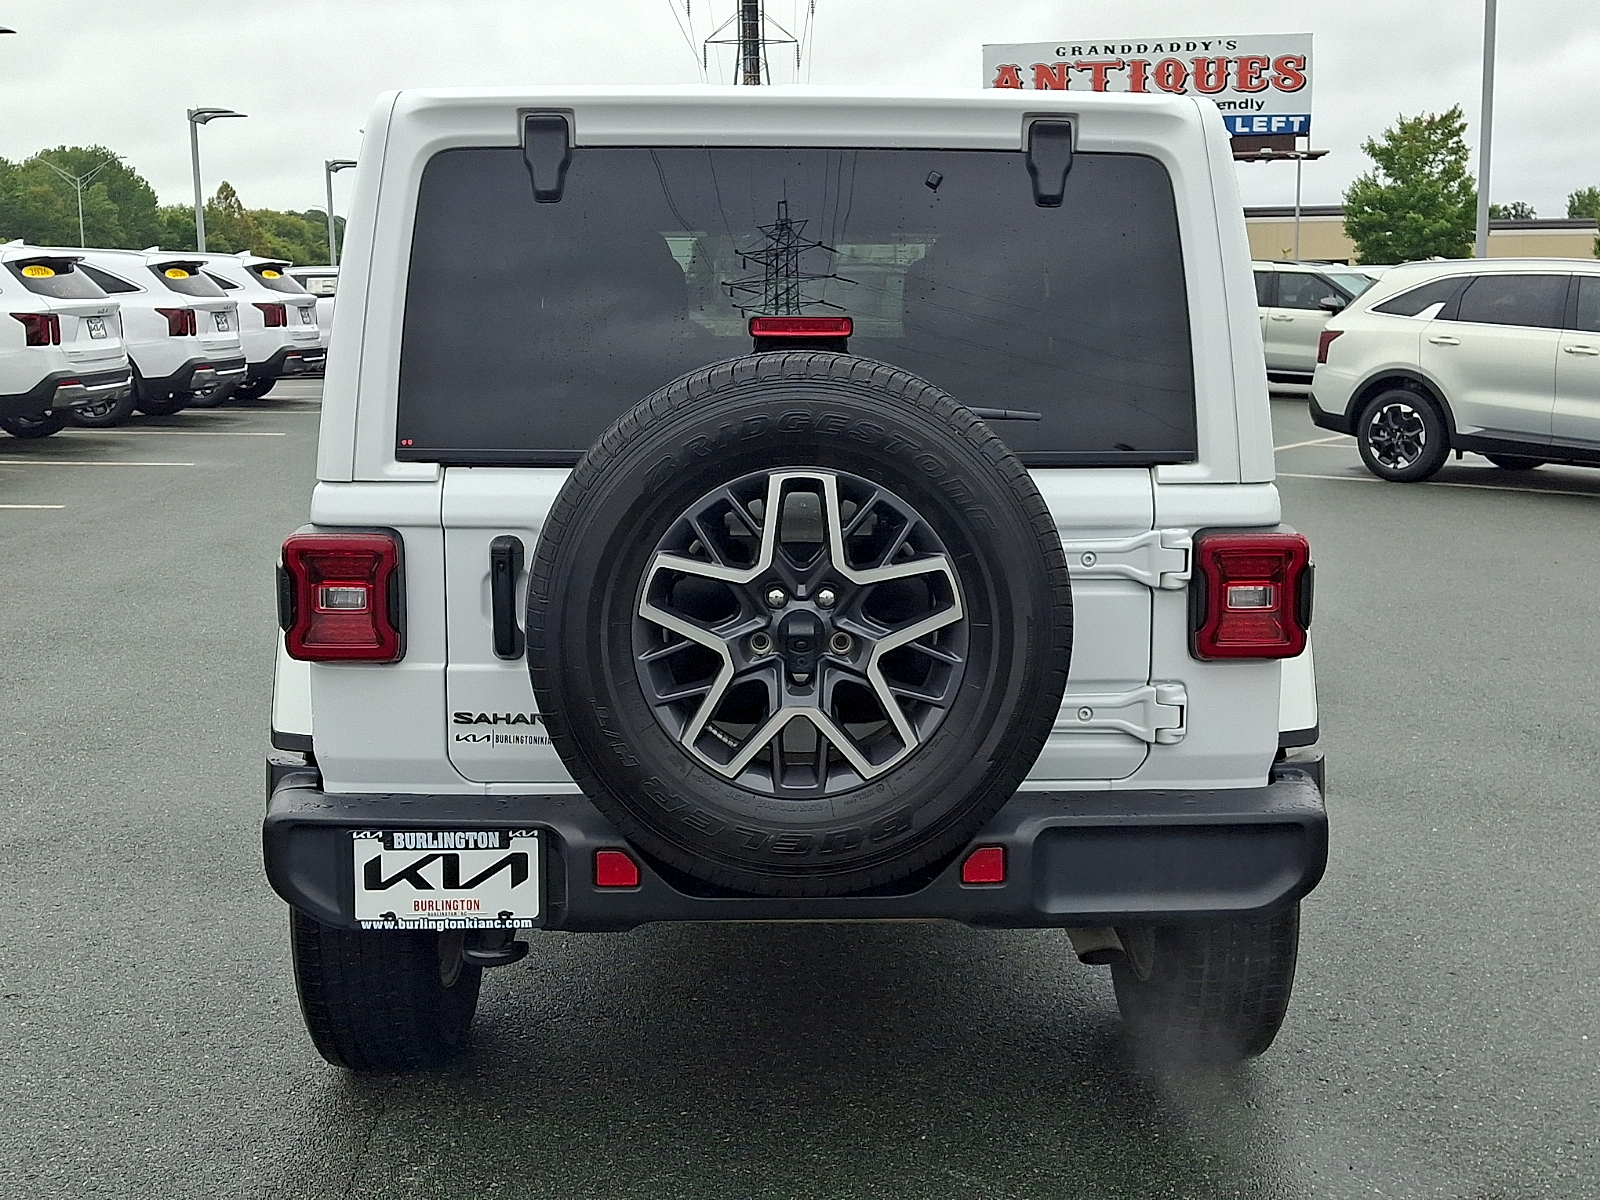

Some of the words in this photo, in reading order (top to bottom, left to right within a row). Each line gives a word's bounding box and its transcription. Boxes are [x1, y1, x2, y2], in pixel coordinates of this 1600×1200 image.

[1055, 40, 1238, 56] GRANDDADDY'S
[992, 54, 1308, 95] ANTIQUES
[1213, 98, 1265, 111] endly
[1235, 116, 1305, 132] LEFT
[353, 831, 383, 839] KIA
[393, 832, 500, 849] BURLINGTON
[364, 853, 529, 890] KIA
[413, 900, 480, 911] BURLINGTON
[361, 917, 533, 932] www.burlingtonkianc.com
